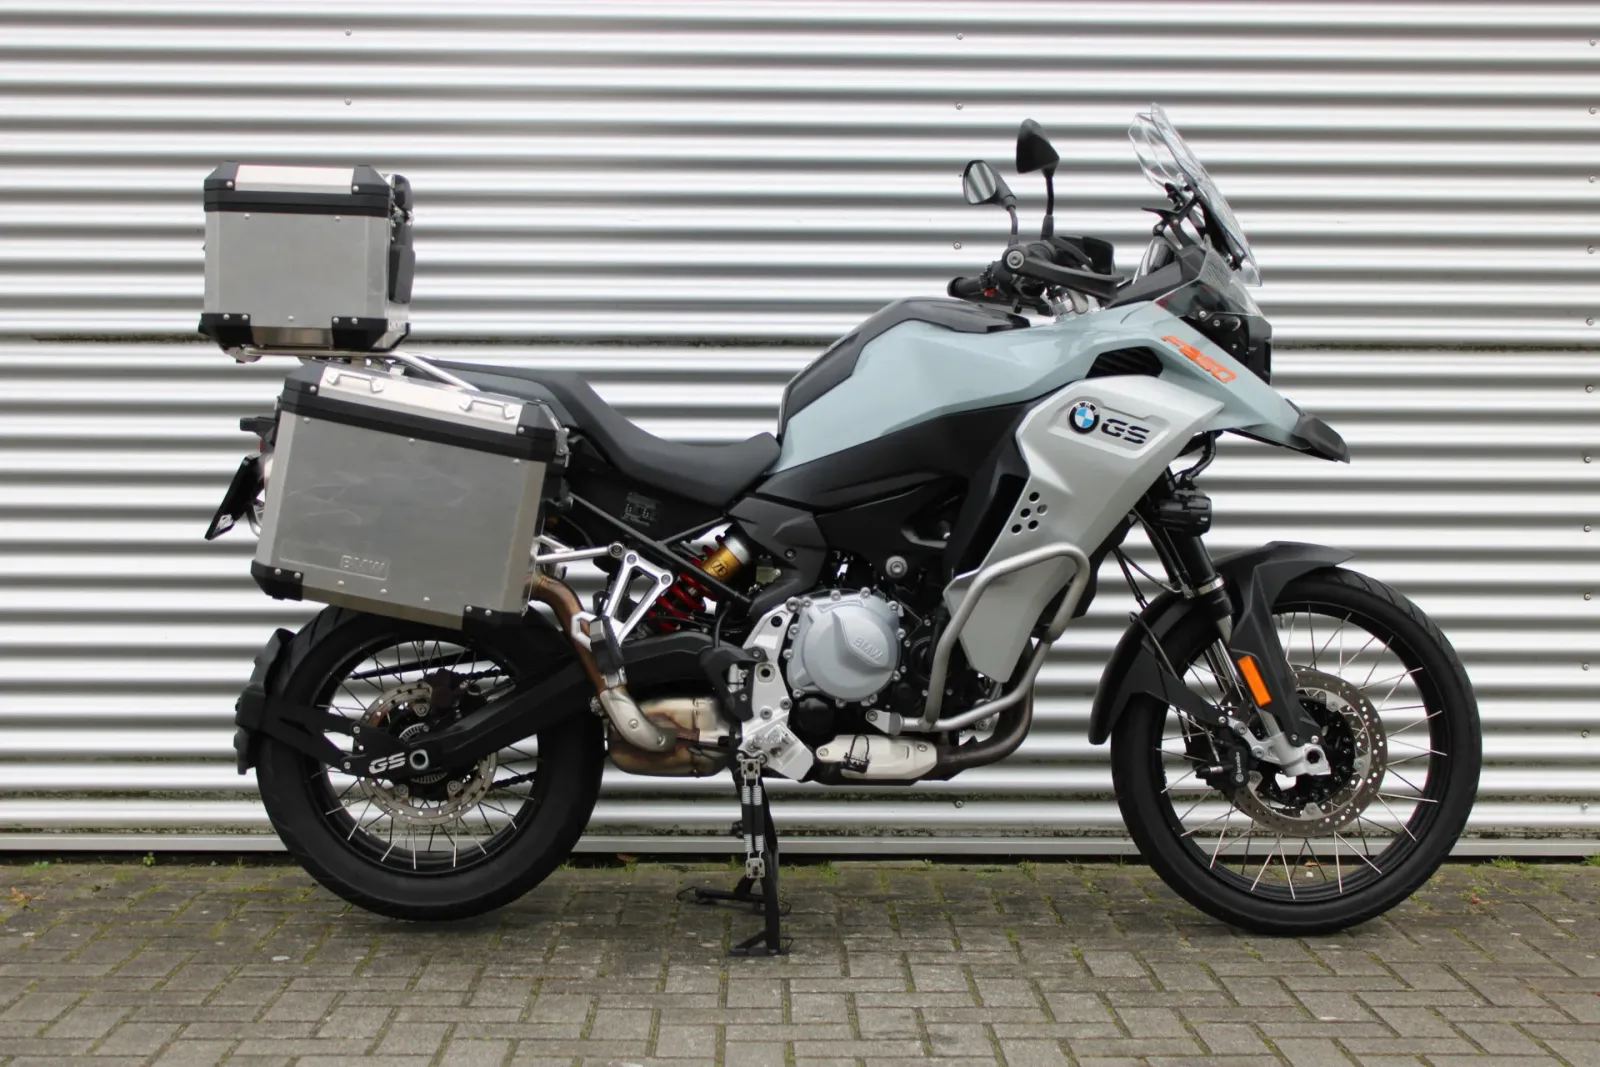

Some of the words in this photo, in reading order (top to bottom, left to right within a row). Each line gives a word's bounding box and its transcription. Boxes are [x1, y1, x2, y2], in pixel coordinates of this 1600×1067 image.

[1101, 418, 1150, 444] GS
[342, 554, 386, 574] BMW
[853, 635, 883, 660] BMW
[368, 752, 406, 774] GS
